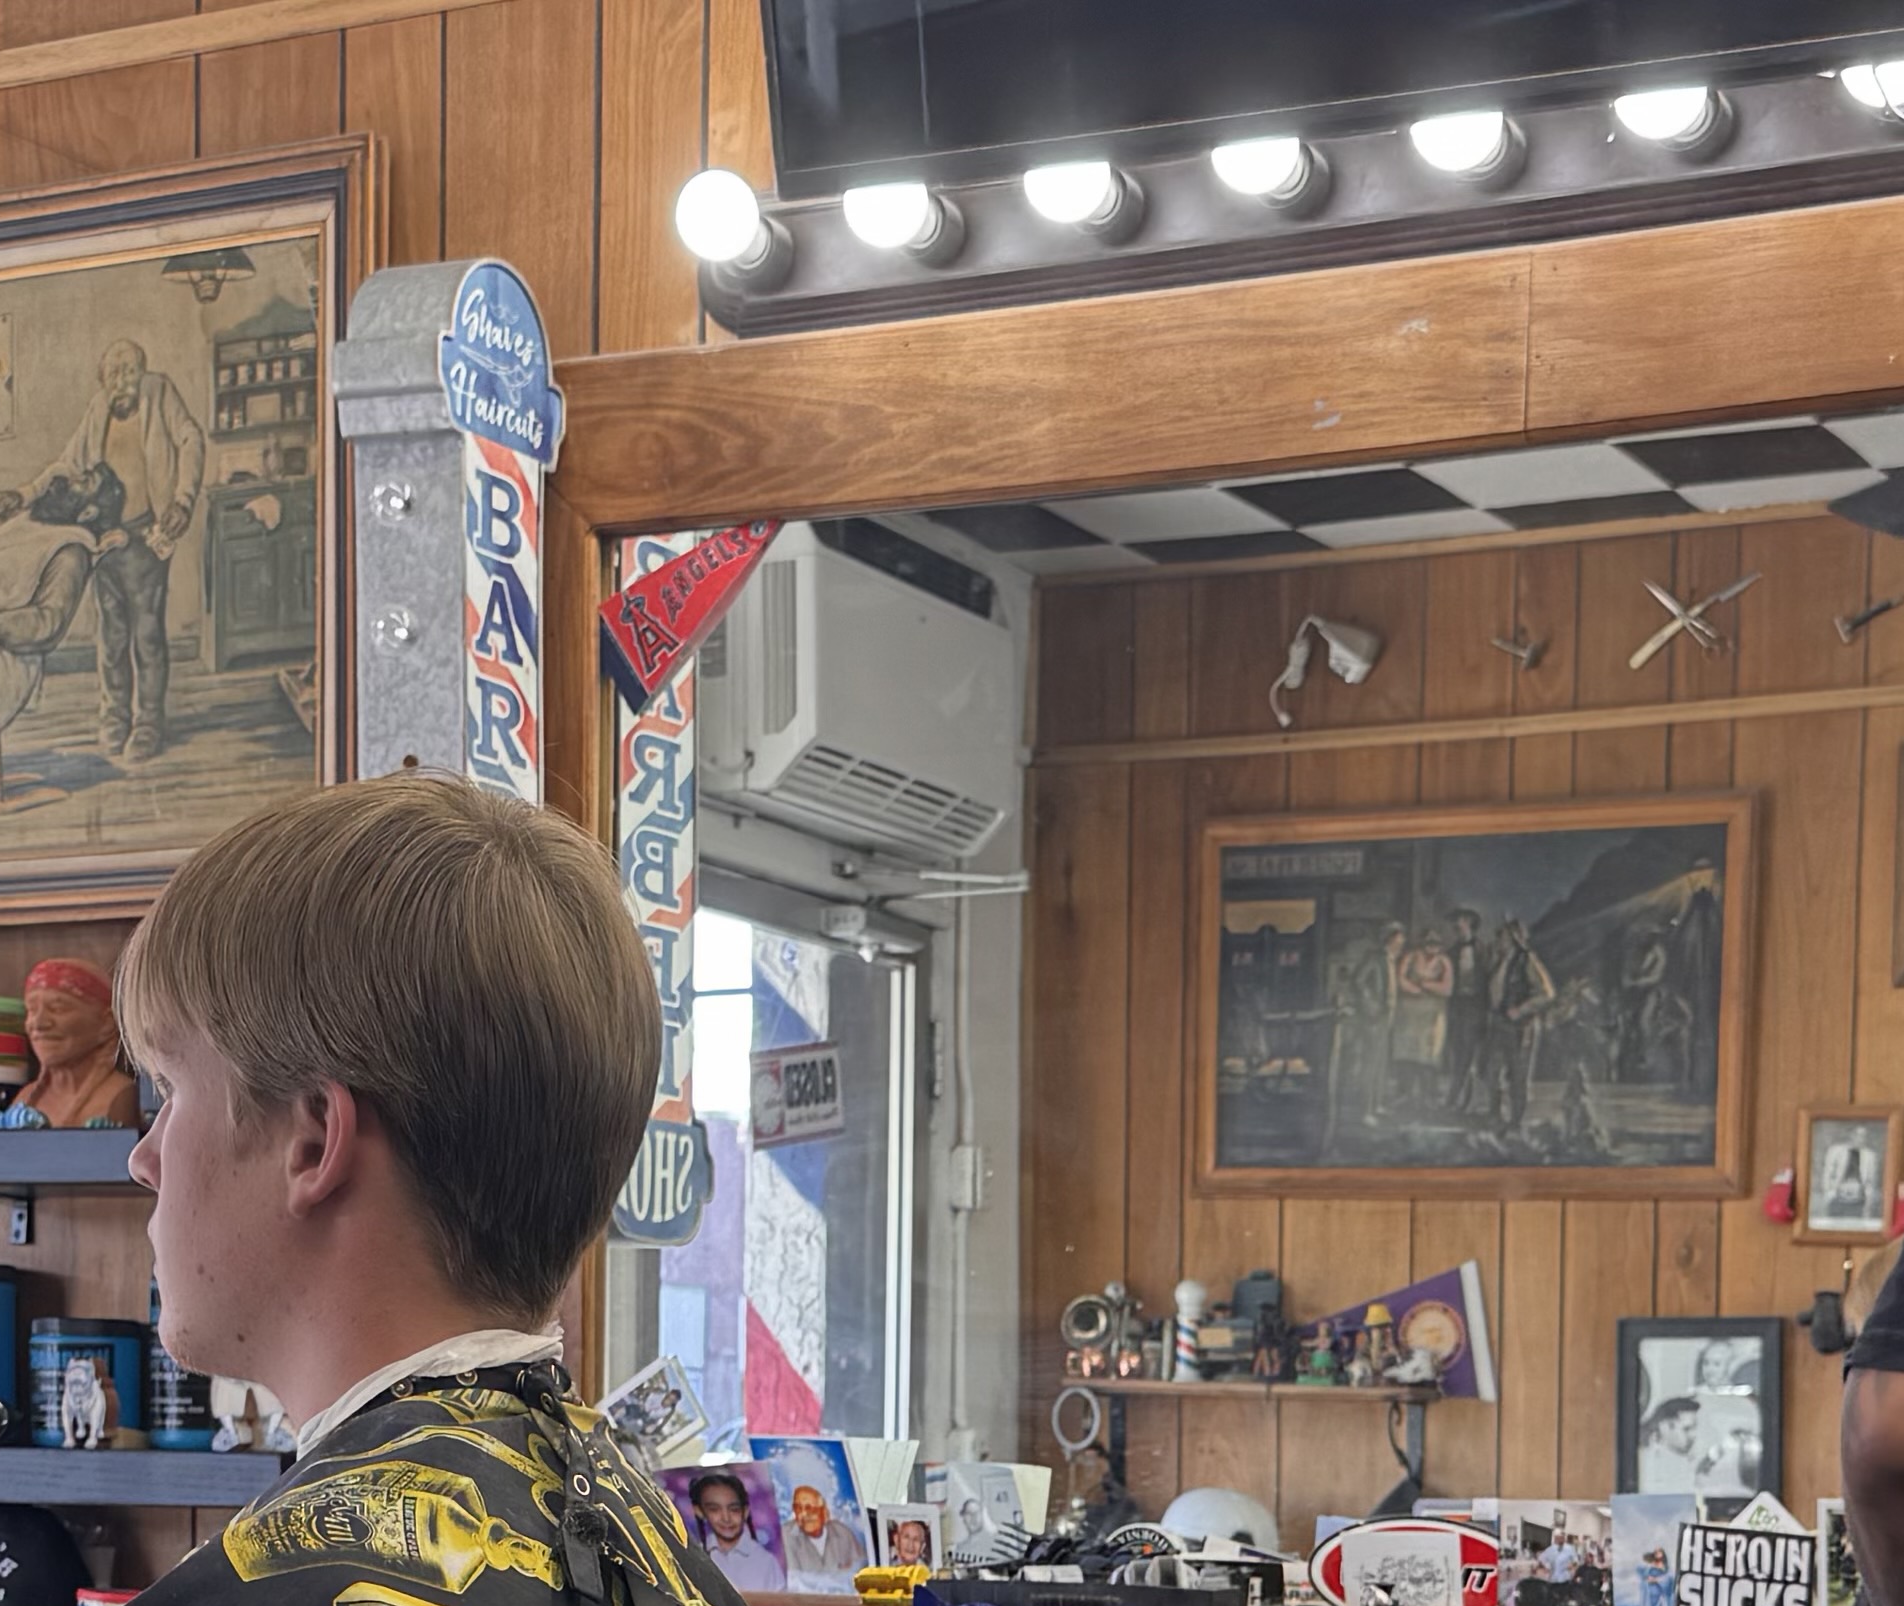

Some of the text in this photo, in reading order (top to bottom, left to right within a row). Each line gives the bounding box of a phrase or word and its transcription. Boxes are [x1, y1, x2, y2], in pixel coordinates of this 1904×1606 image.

[461, 287, 537, 367] Shaves
[448, 360, 545, 450] Haircuts
[661, 530, 751, 625] ANGELS
[472, 467, 530, 798] BAR
[1680, 1525, 1811, 1584] HEROIN
